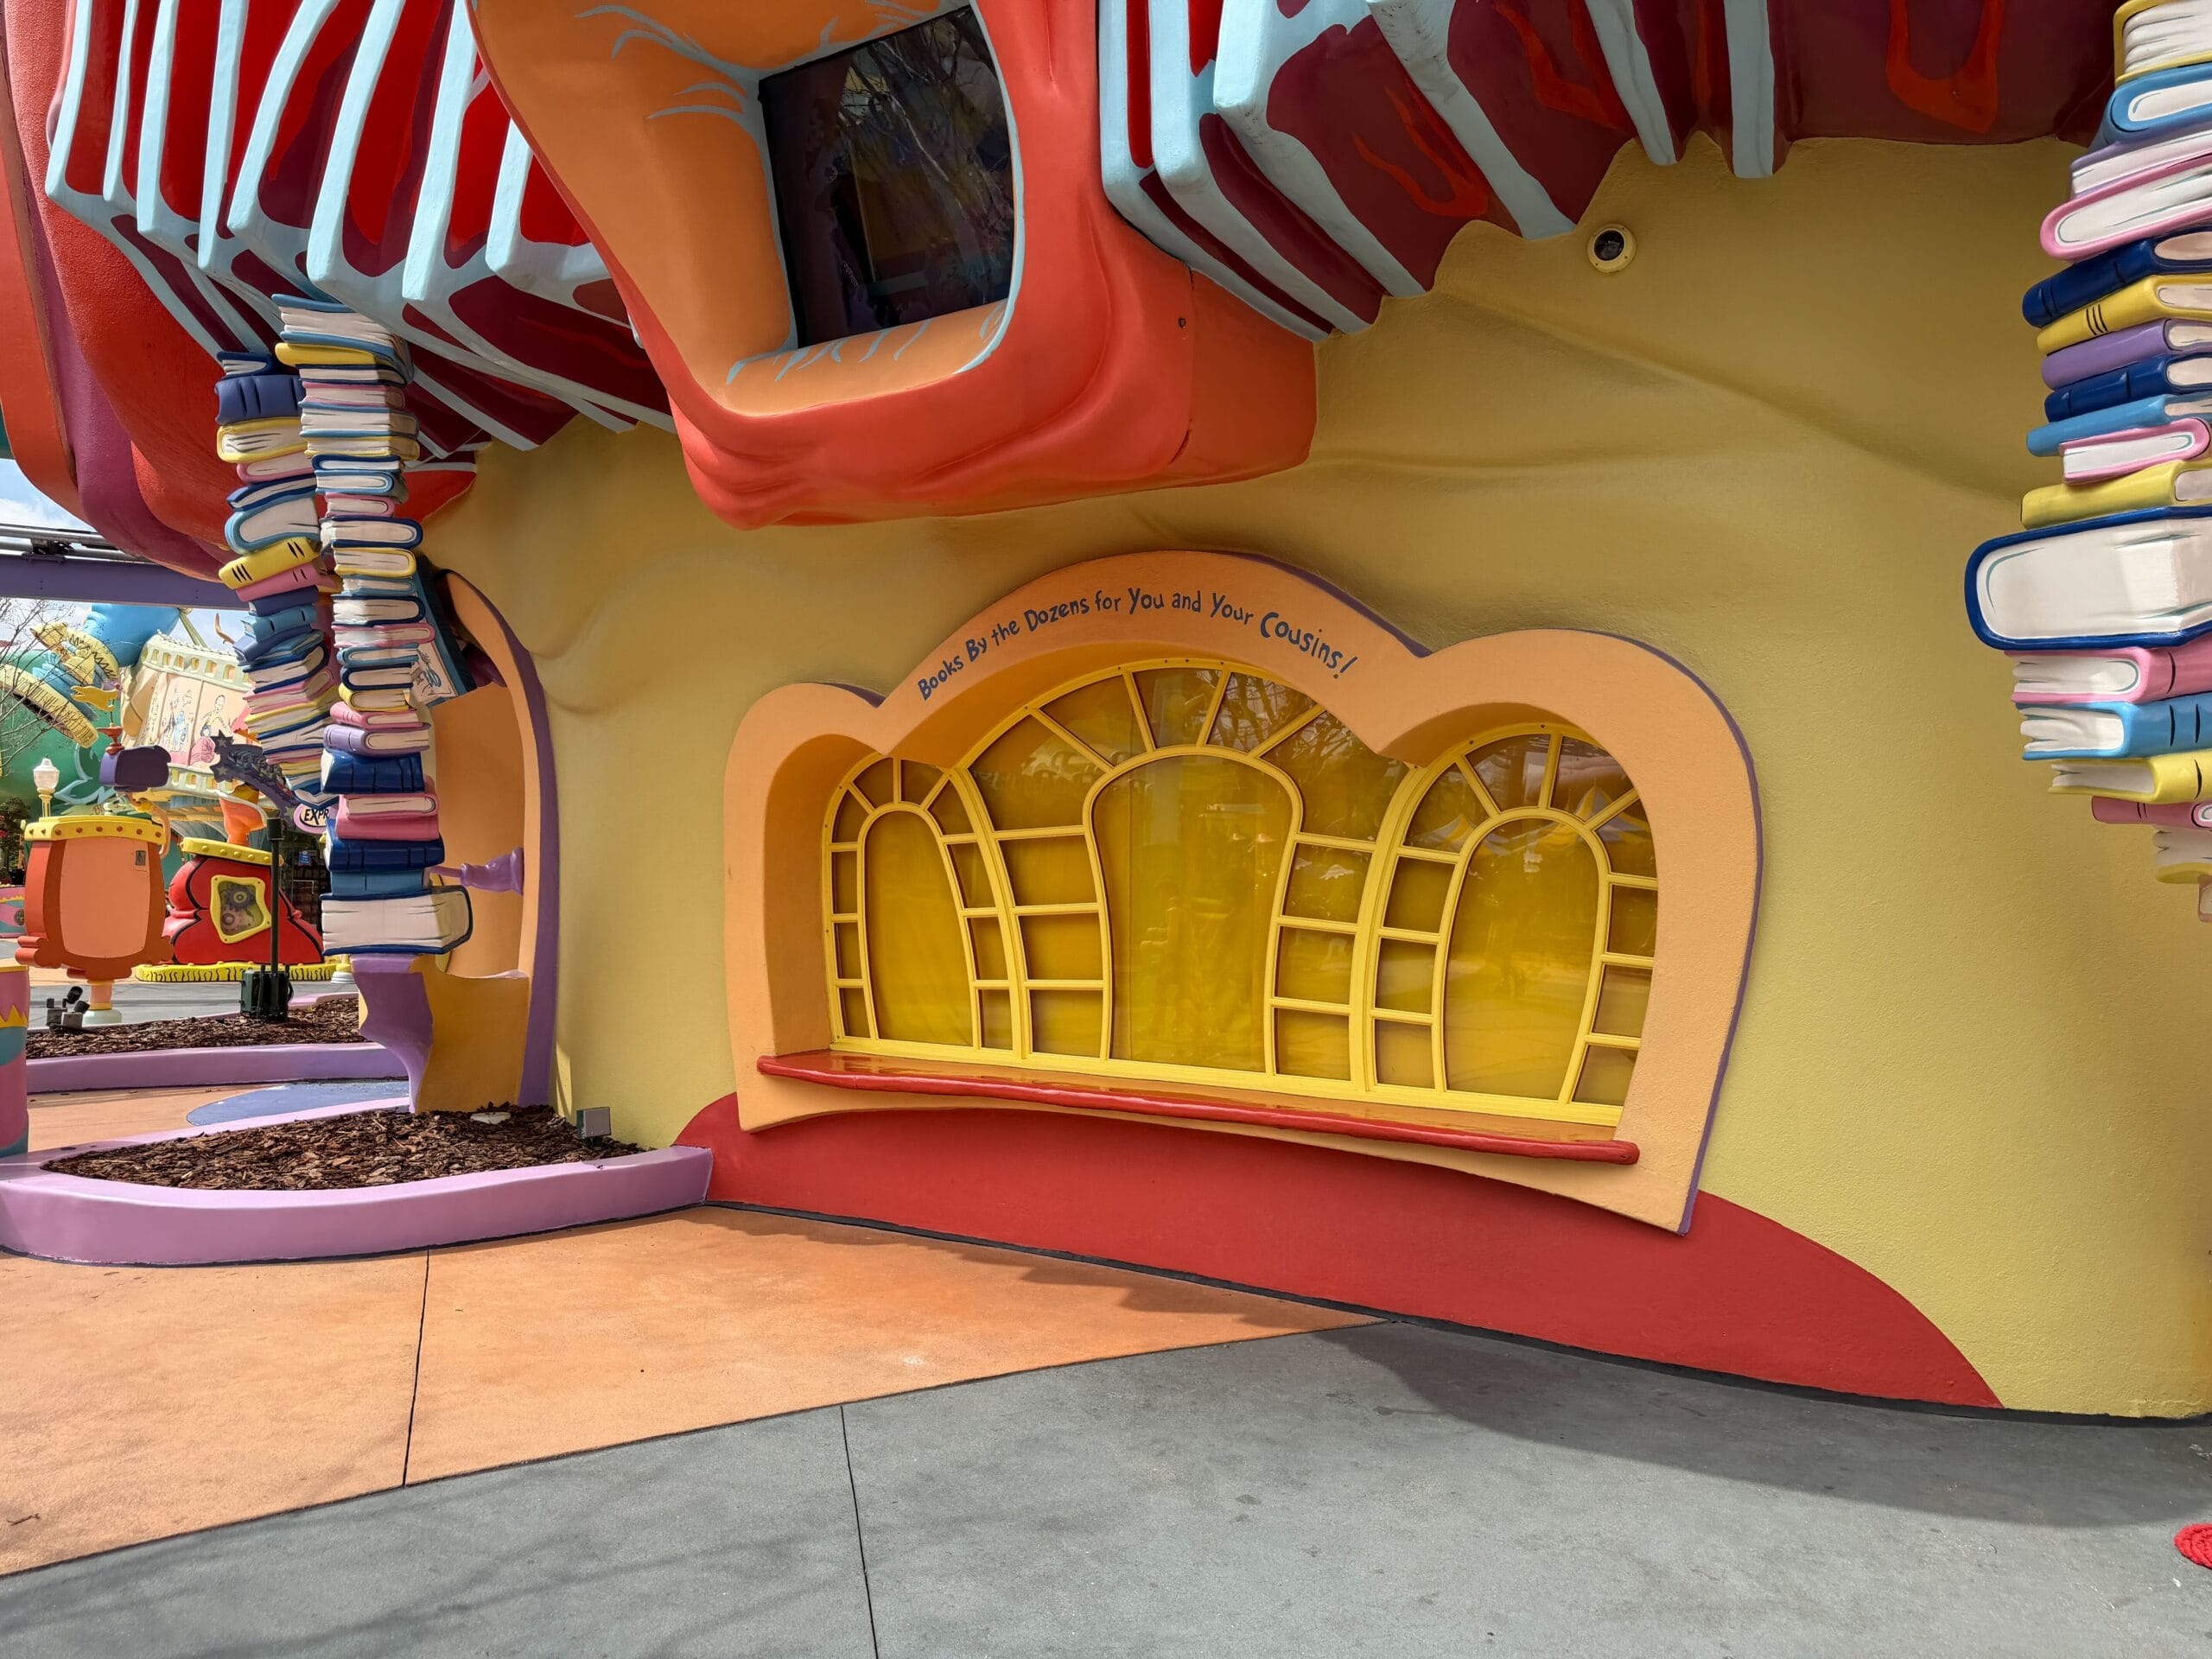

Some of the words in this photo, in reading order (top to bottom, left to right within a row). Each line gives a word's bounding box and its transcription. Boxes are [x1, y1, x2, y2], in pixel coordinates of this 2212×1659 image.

[917, 655, 965, 701] Books
[965, 638, 988, 663] By
[991, 620, 1020, 647] the
[1023, 596, 1090, 632] Dozens
[1095, 589, 1122, 613] for
[1127, 587, 1165, 616] You
[1172, 590, 1203, 613] and
[1211, 592, 1255, 626] Your
[1259, 611, 1359, 680] Cousins!
